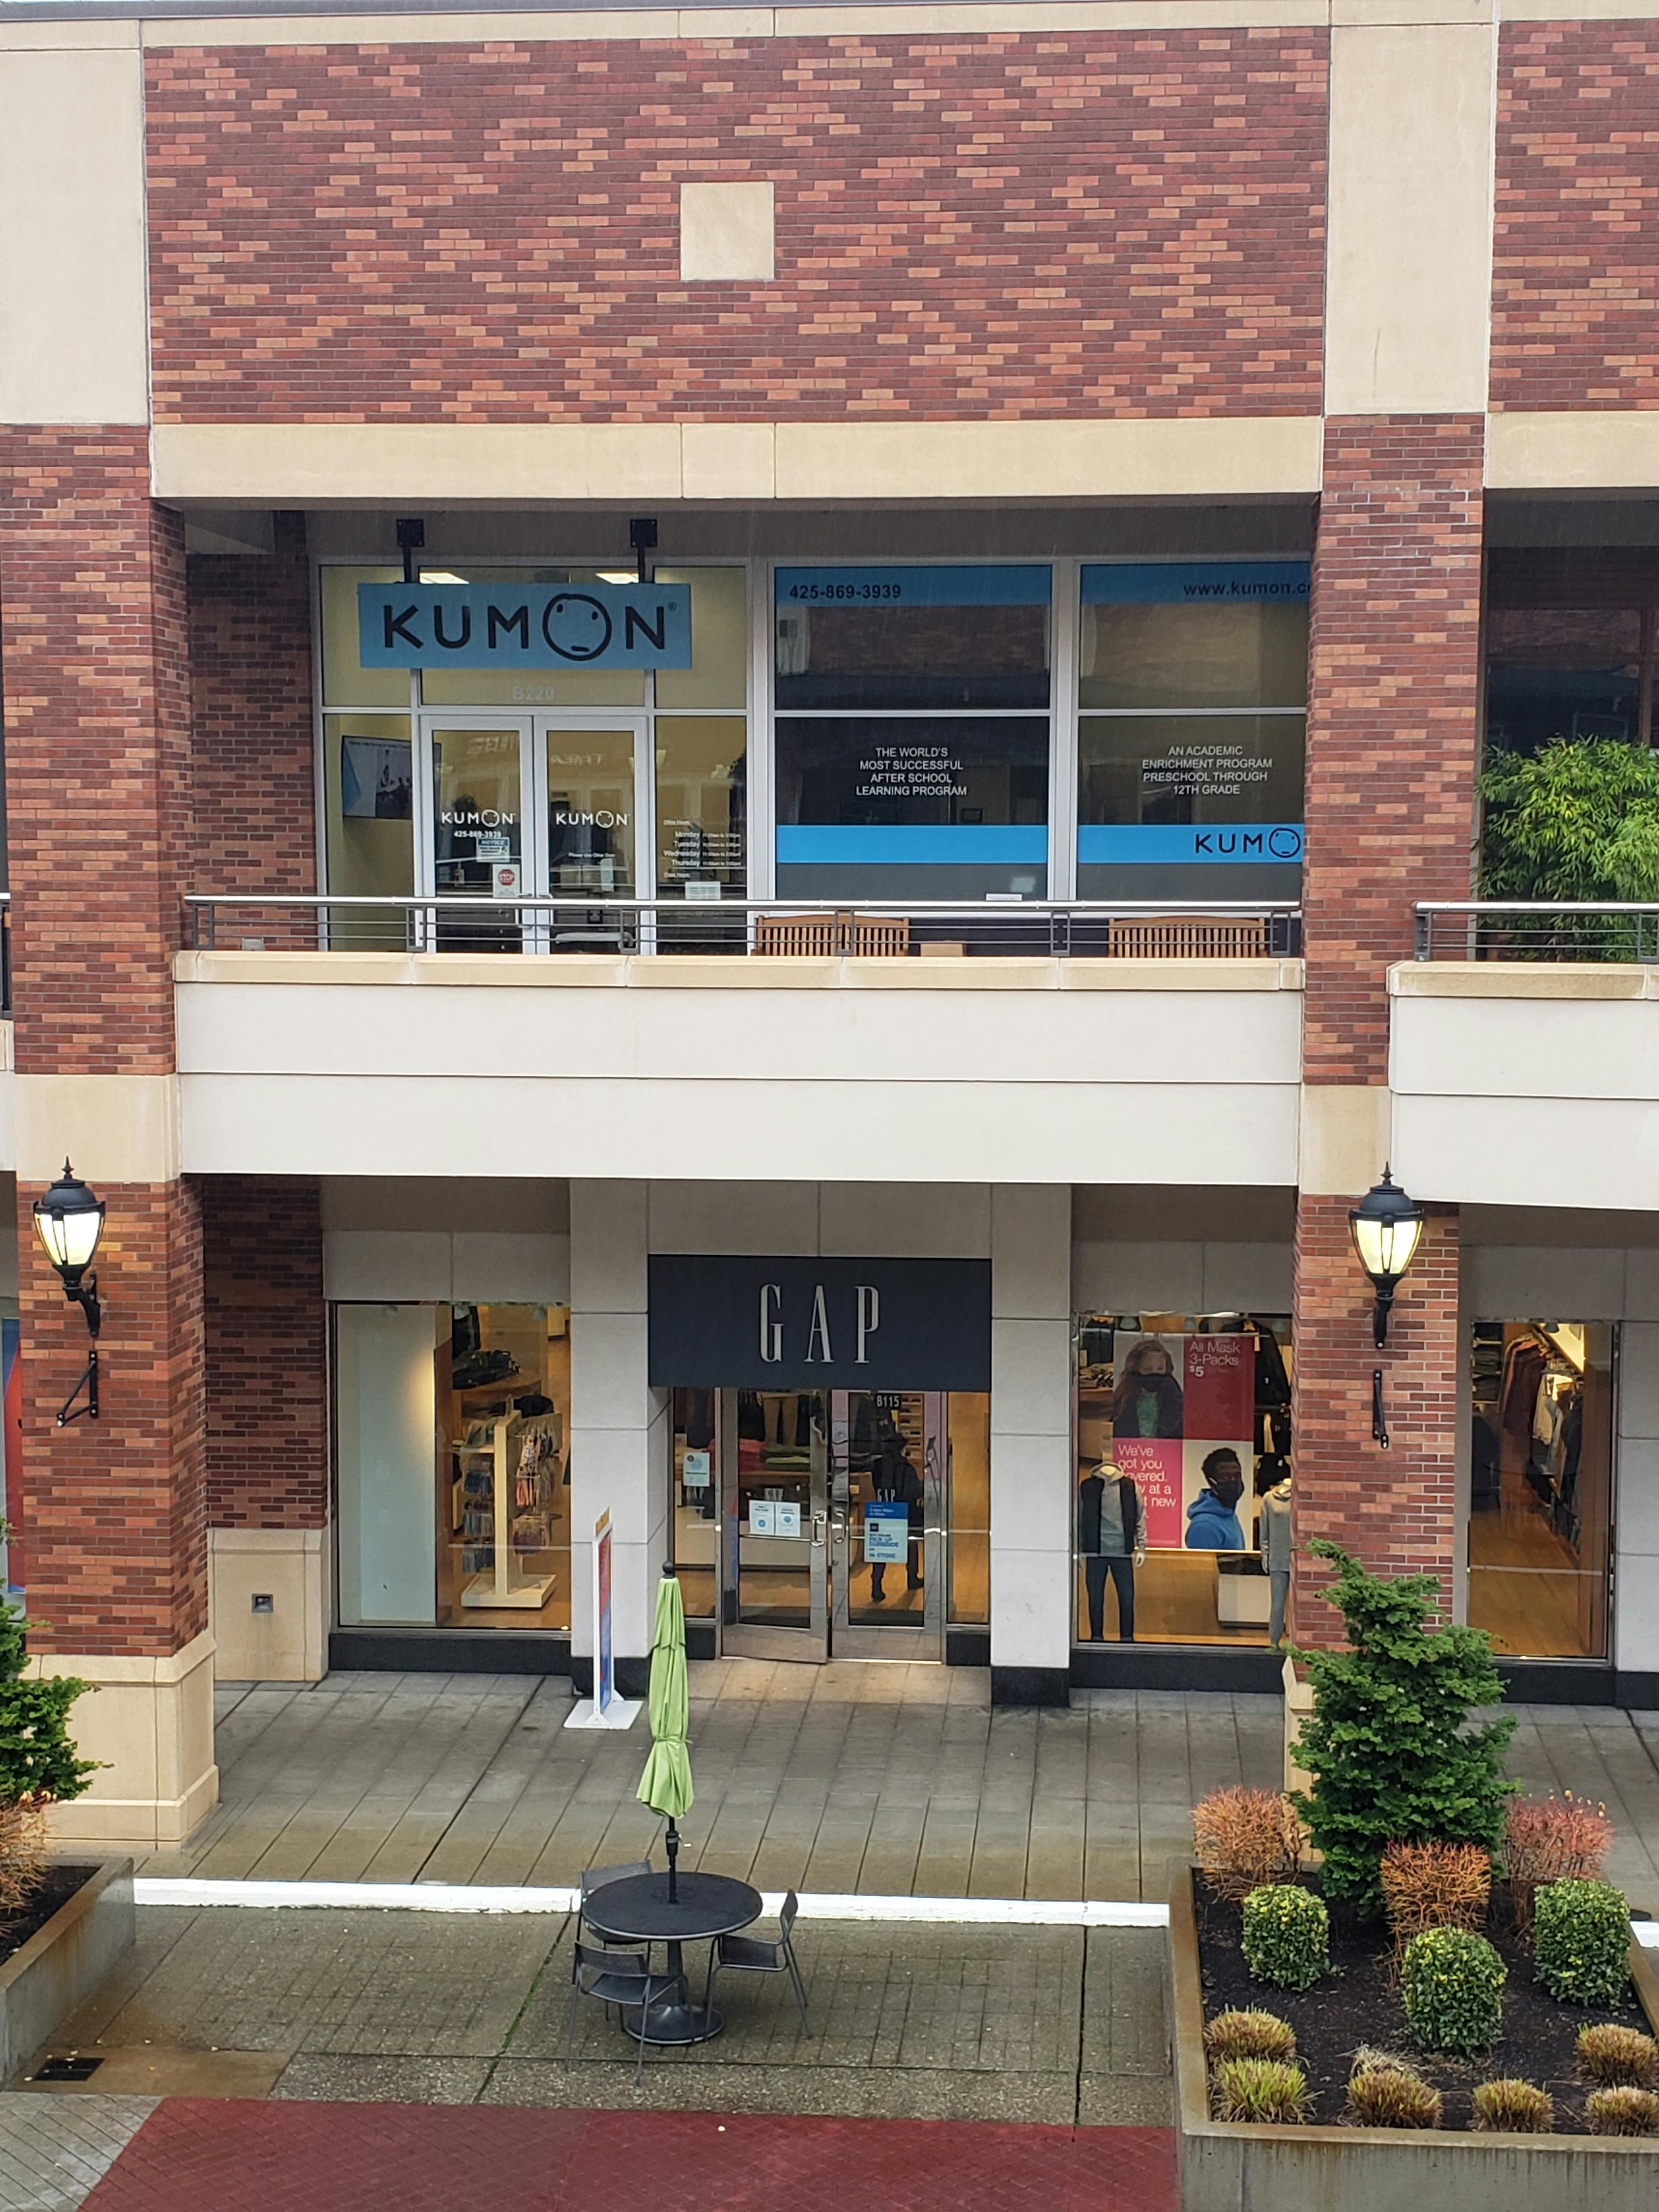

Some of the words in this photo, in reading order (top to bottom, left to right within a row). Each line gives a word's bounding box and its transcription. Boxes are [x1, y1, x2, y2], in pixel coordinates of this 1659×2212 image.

[789, 585, 901, 599] 425-869-3939
[1184, 581, 1310, 595] www.kumon.c
[512, 686, 554, 701] B220
[876, 747, 896, 757] THE
[899, 747, 948, 757] WORLD'S
[1168, 746, 1183, 755] AN
[1186, 746, 1243, 755] ACADEMIC
[860, 760, 891, 770] MOST
[893, 760, 964, 770] SUCCESSFUL
[1142, 759, 1214, 769] ENRICHMENT
[1216, 759, 1272, 768] PROGRAM
[870, 774, 905, 783] AFTER
[908, 773, 952, 783] SCHOOL
[1143, 772, 1211, 782] PRESCHOOL
[1212, 771, 1267, 781] THROUGH
[856, 786, 910, 795] LEARNING
[912, 786, 967, 795] PROGRAM
[1173, 785, 1199, 794] 12TH
[1201, 785, 1240, 794] GRADE
[441, 809, 514, 827] KUMON
[556, 810, 628, 828] KUMON
[675, 831, 699, 839] Monday
[674, 840, 699, 849] Tuesday
[1195, 827, 1301, 858] KUMO
[663, 850, 699, 858] Wednesday
[672, 859, 699, 867] Thursday
[760, 1284, 879, 1363] GAP
[1189, 1341, 1204, 1352] All
[1208, 1342, 1240, 1353] Mask
[1189, 1353, 1239, 1365] 3-Packs
[1189, 1365, 1204, 1377] $5
[877, 1396, 900, 1407] B115
[1118, 1445, 1154, 1457] We've
[1118, 1459, 1137, 1471] got
[1141, 1460, 1163, 1471] you
[1125, 1470, 1168, 1482] overed.
[1149, 1483, 1160, 1494] at
[1164, 1486, 1171, 1494] a
[1152, 1497, 1176, 1507] new
